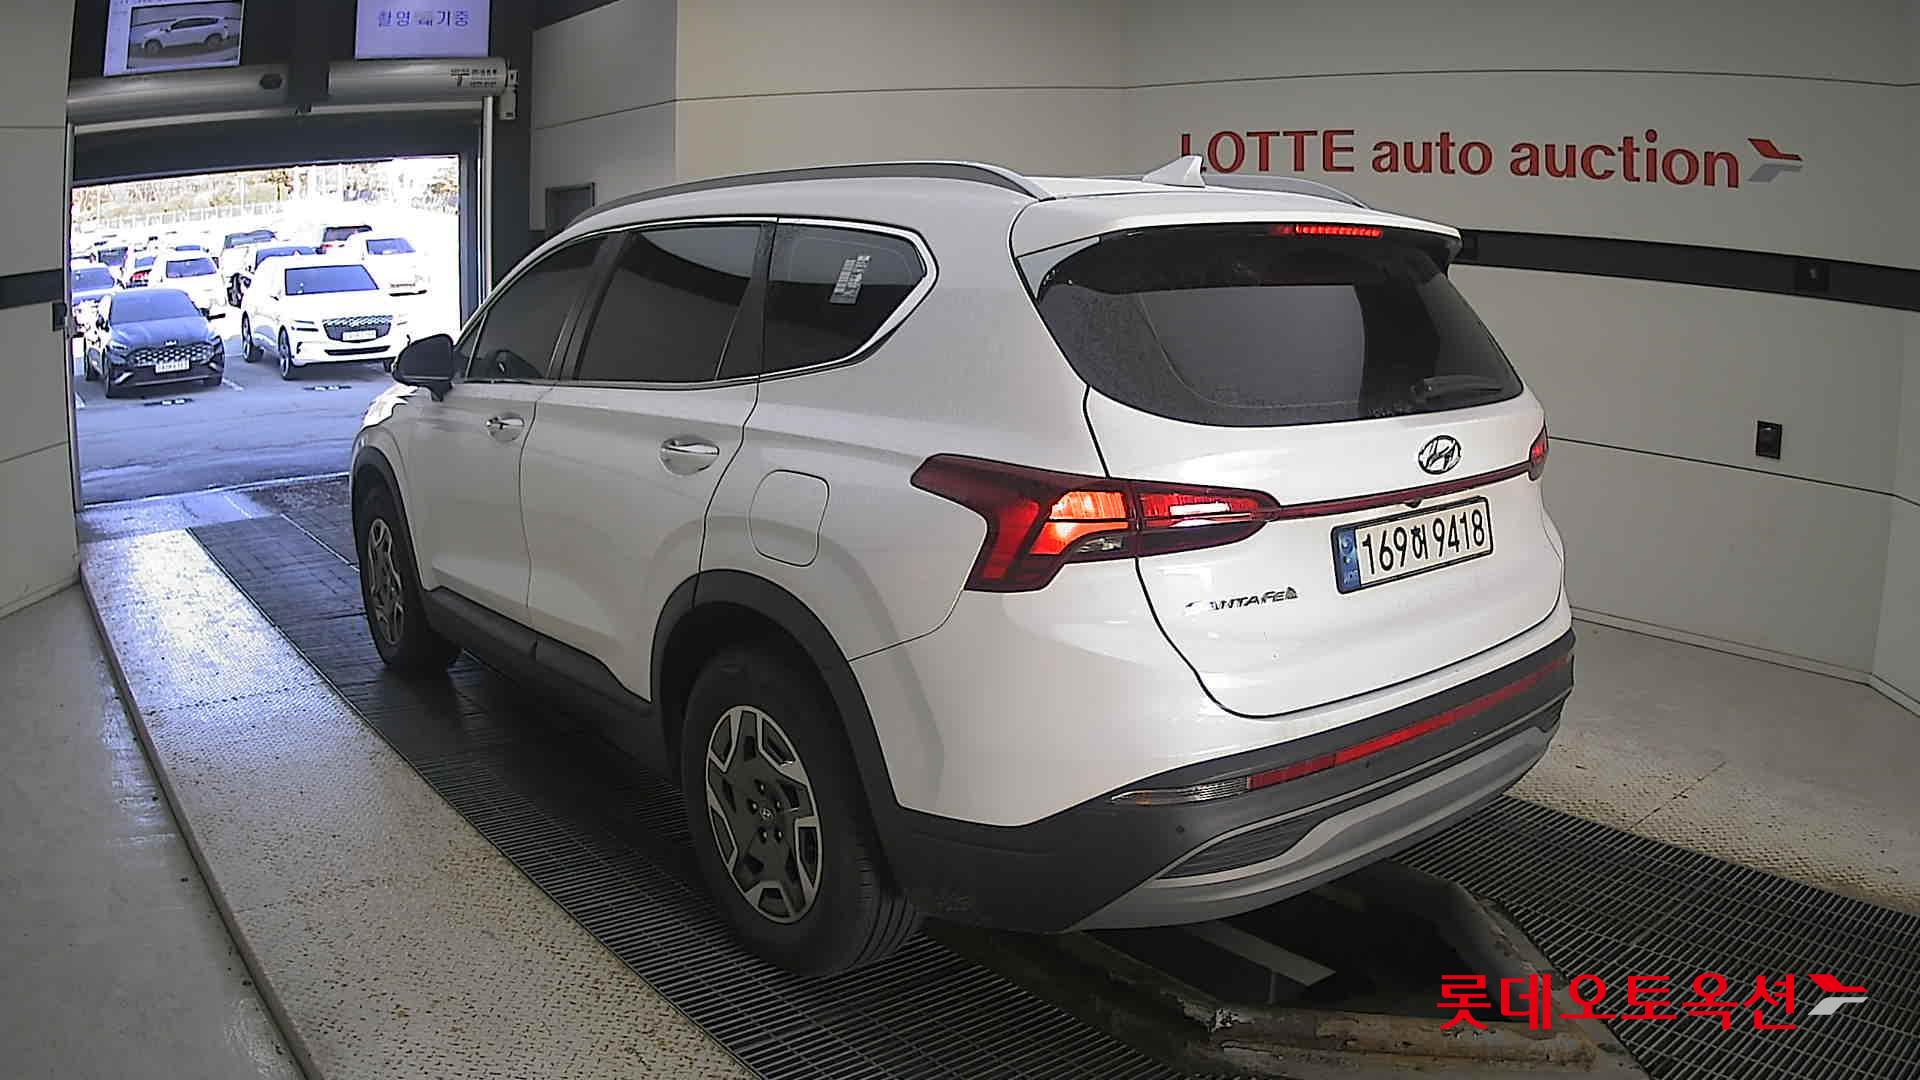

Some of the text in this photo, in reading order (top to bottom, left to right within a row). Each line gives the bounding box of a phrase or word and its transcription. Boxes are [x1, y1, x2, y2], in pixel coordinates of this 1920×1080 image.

[1181, 129, 1740, 189] LOTTE auto auction
